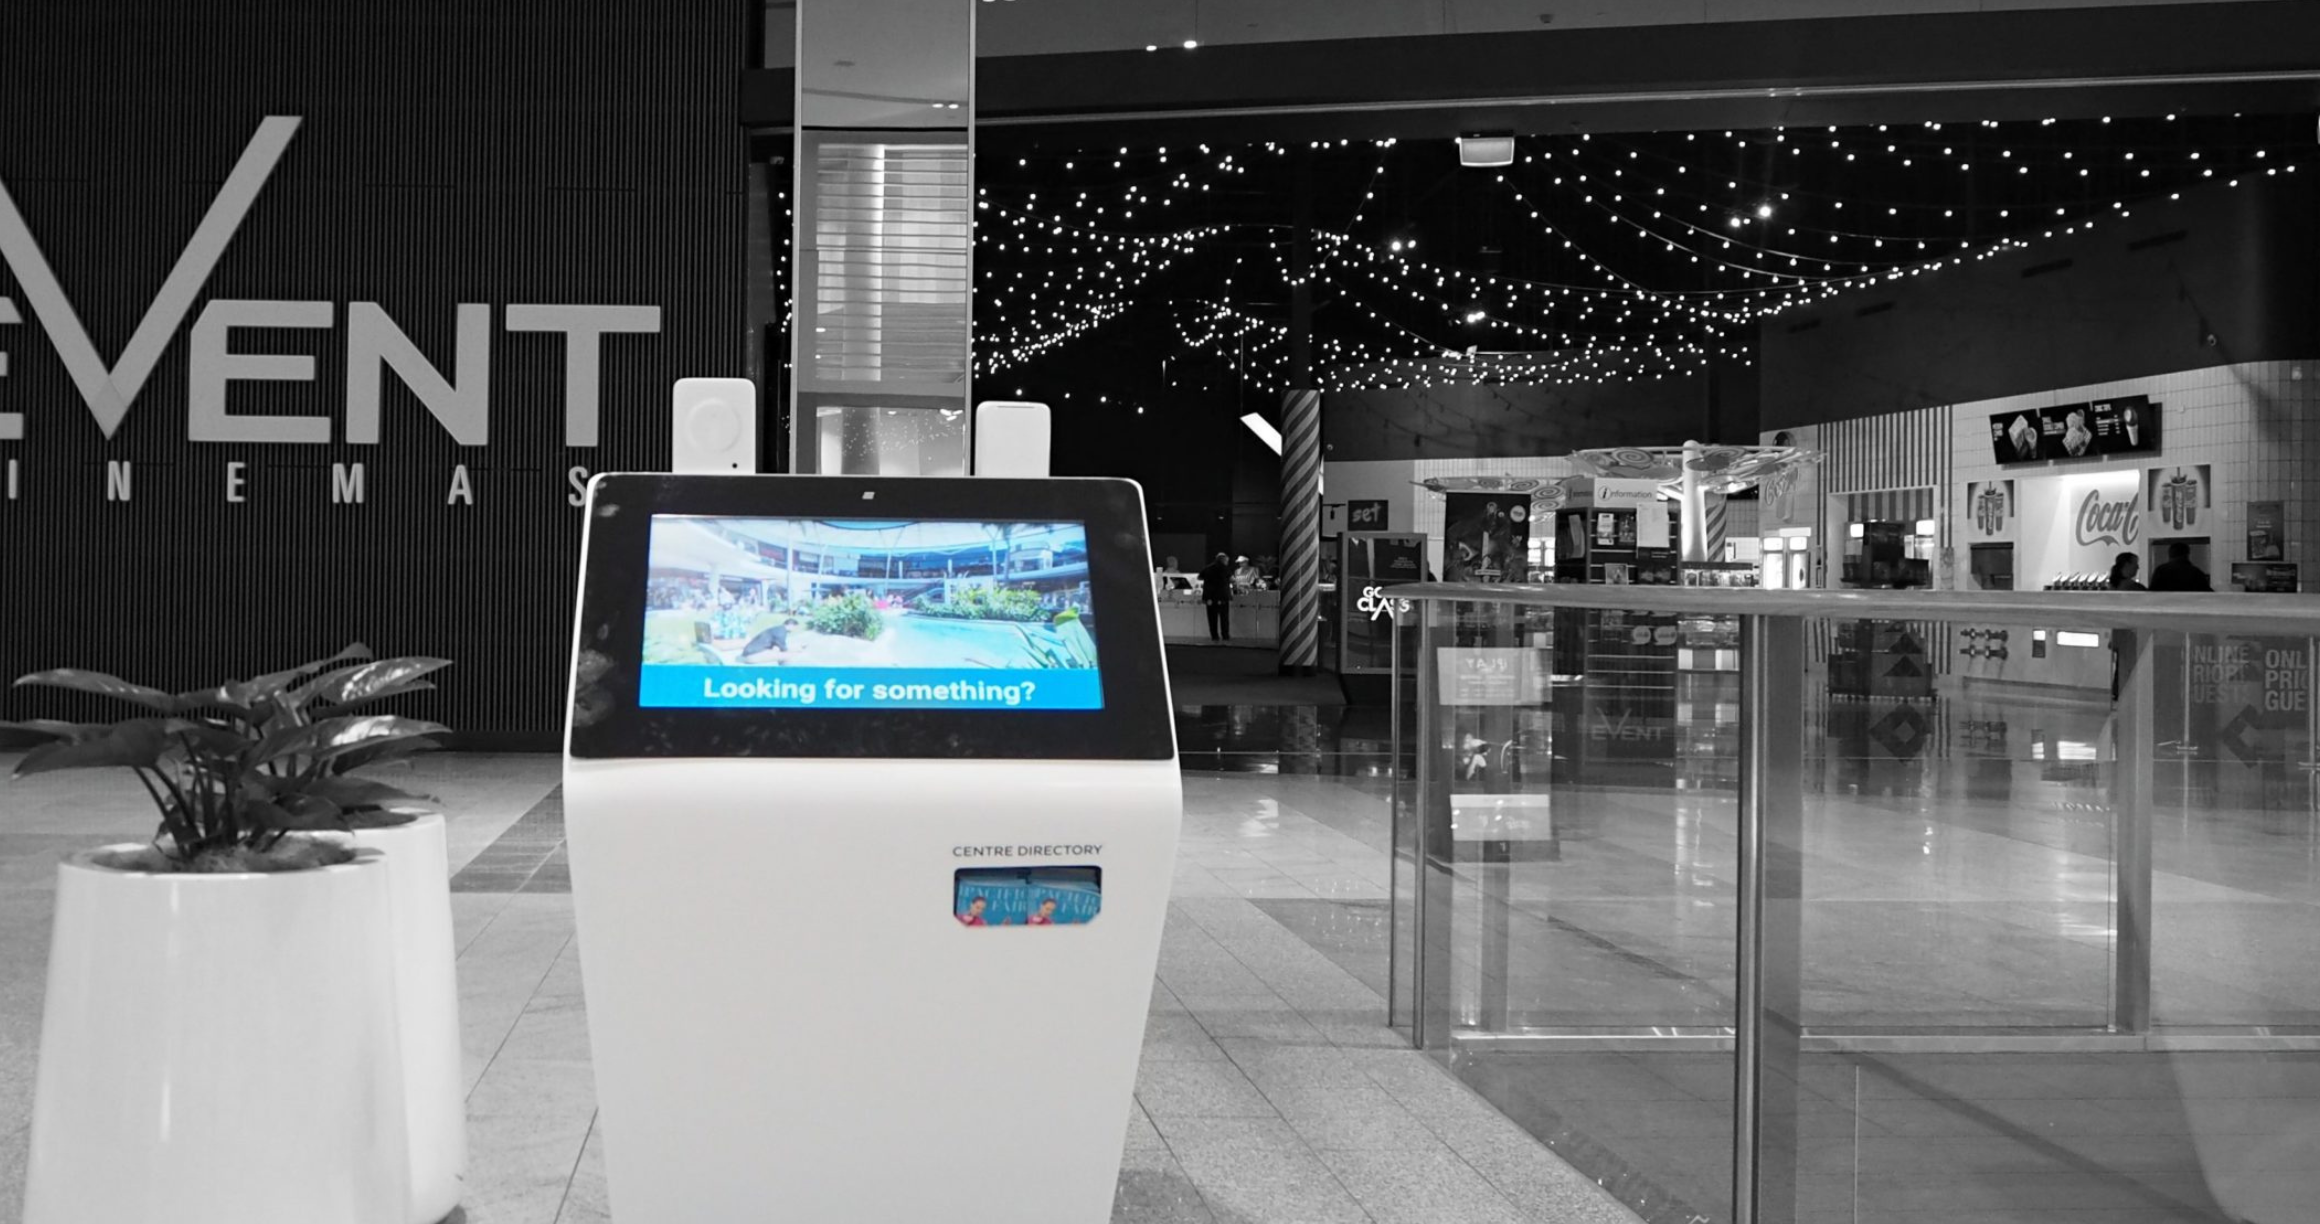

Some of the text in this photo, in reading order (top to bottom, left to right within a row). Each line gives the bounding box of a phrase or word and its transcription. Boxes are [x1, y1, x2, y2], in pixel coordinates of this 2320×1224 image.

[0, 115, 661, 447] VENT
[1352, 502, 1382, 523] set
[703, 677, 1036, 705] Looking for something?
[952, 844, 1103, 857] CENTRE DIRECTORY
